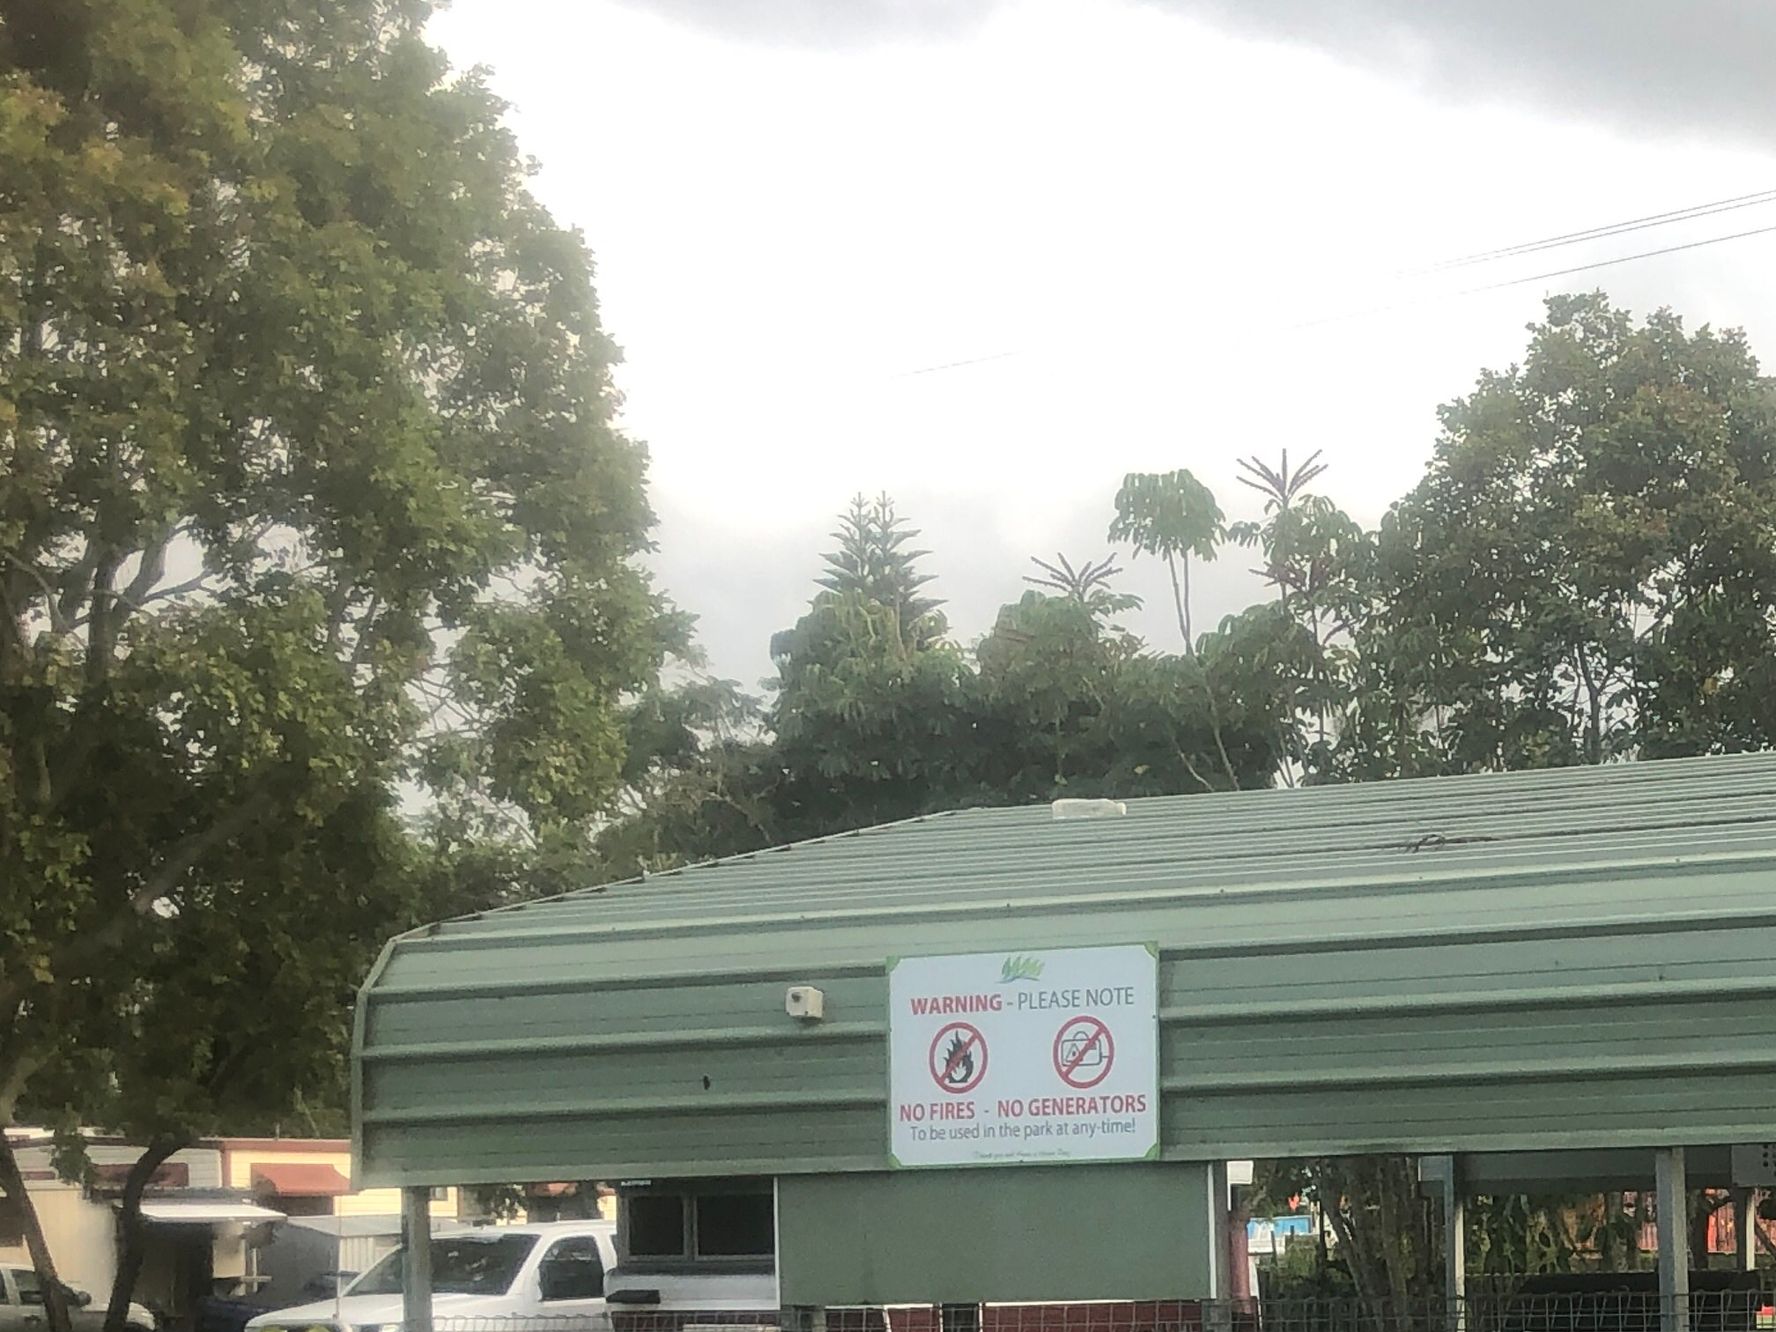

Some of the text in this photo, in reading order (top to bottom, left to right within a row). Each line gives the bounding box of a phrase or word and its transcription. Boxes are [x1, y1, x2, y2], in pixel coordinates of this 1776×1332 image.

[911, 994, 1003, 1016] WARNING
[1018, 989, 1081, 1011] PLEASE
[1085, 986, 1135, 1008] NOTE
[899, 1103, 925, 1122] NO
[929, 1101, 976, 1121] FIRES
[997, 1099, 1024, 1118] NO
[1028, 1094, 1147, 1117] GENERATORS
[910, 1125, 927, 1141] To
[930, 1124, 947, 1140] be
[948, 1122, 980, 1140] used
[983, 1123, 997, 1138] in
[999, 1121, 1021, 1138] the
[1023, 1119, 1054, 1141] park
[1056, 1121, 1069, 1136] at
